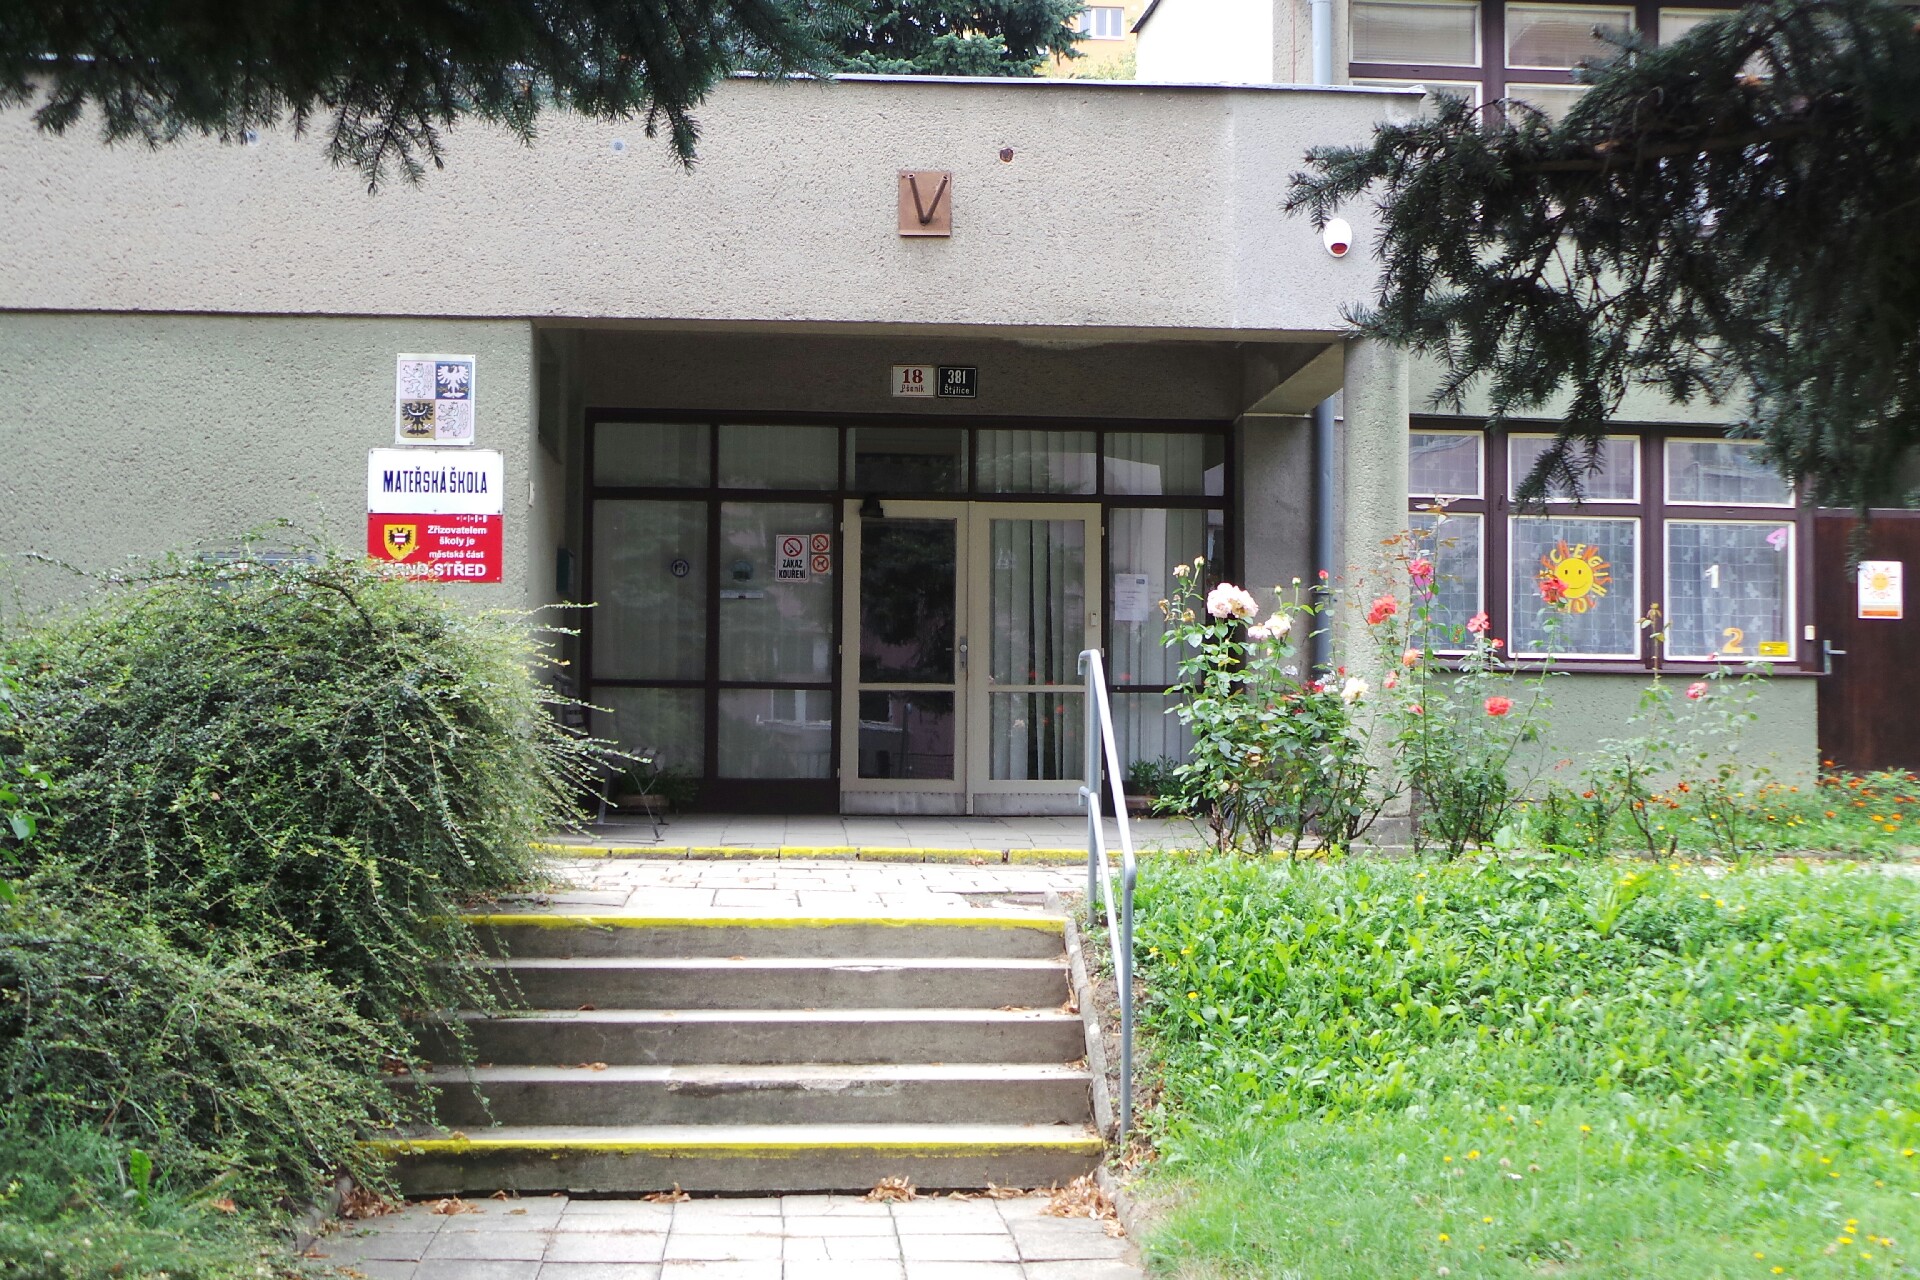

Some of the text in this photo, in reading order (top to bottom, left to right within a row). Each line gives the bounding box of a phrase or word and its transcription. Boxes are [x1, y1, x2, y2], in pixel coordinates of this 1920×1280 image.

[902, 369, 924, 384] 18
[947, 369, 966, 384] 381
[383, 466, 488, 494] MATEŘSKÁ ŠKOLA
[427, 525, 487, 535] Zřizovatelem
[439, 537, 475, 547] školy je
[429, 550, 484, 559] městská část
[783, 558, 803, 568] ZÁKAZ
[779, 568, 806, 578] KOUŘENÍ
[1705, 565, 1719, 589] 1
[1722, 627, 1744, 654] 2
